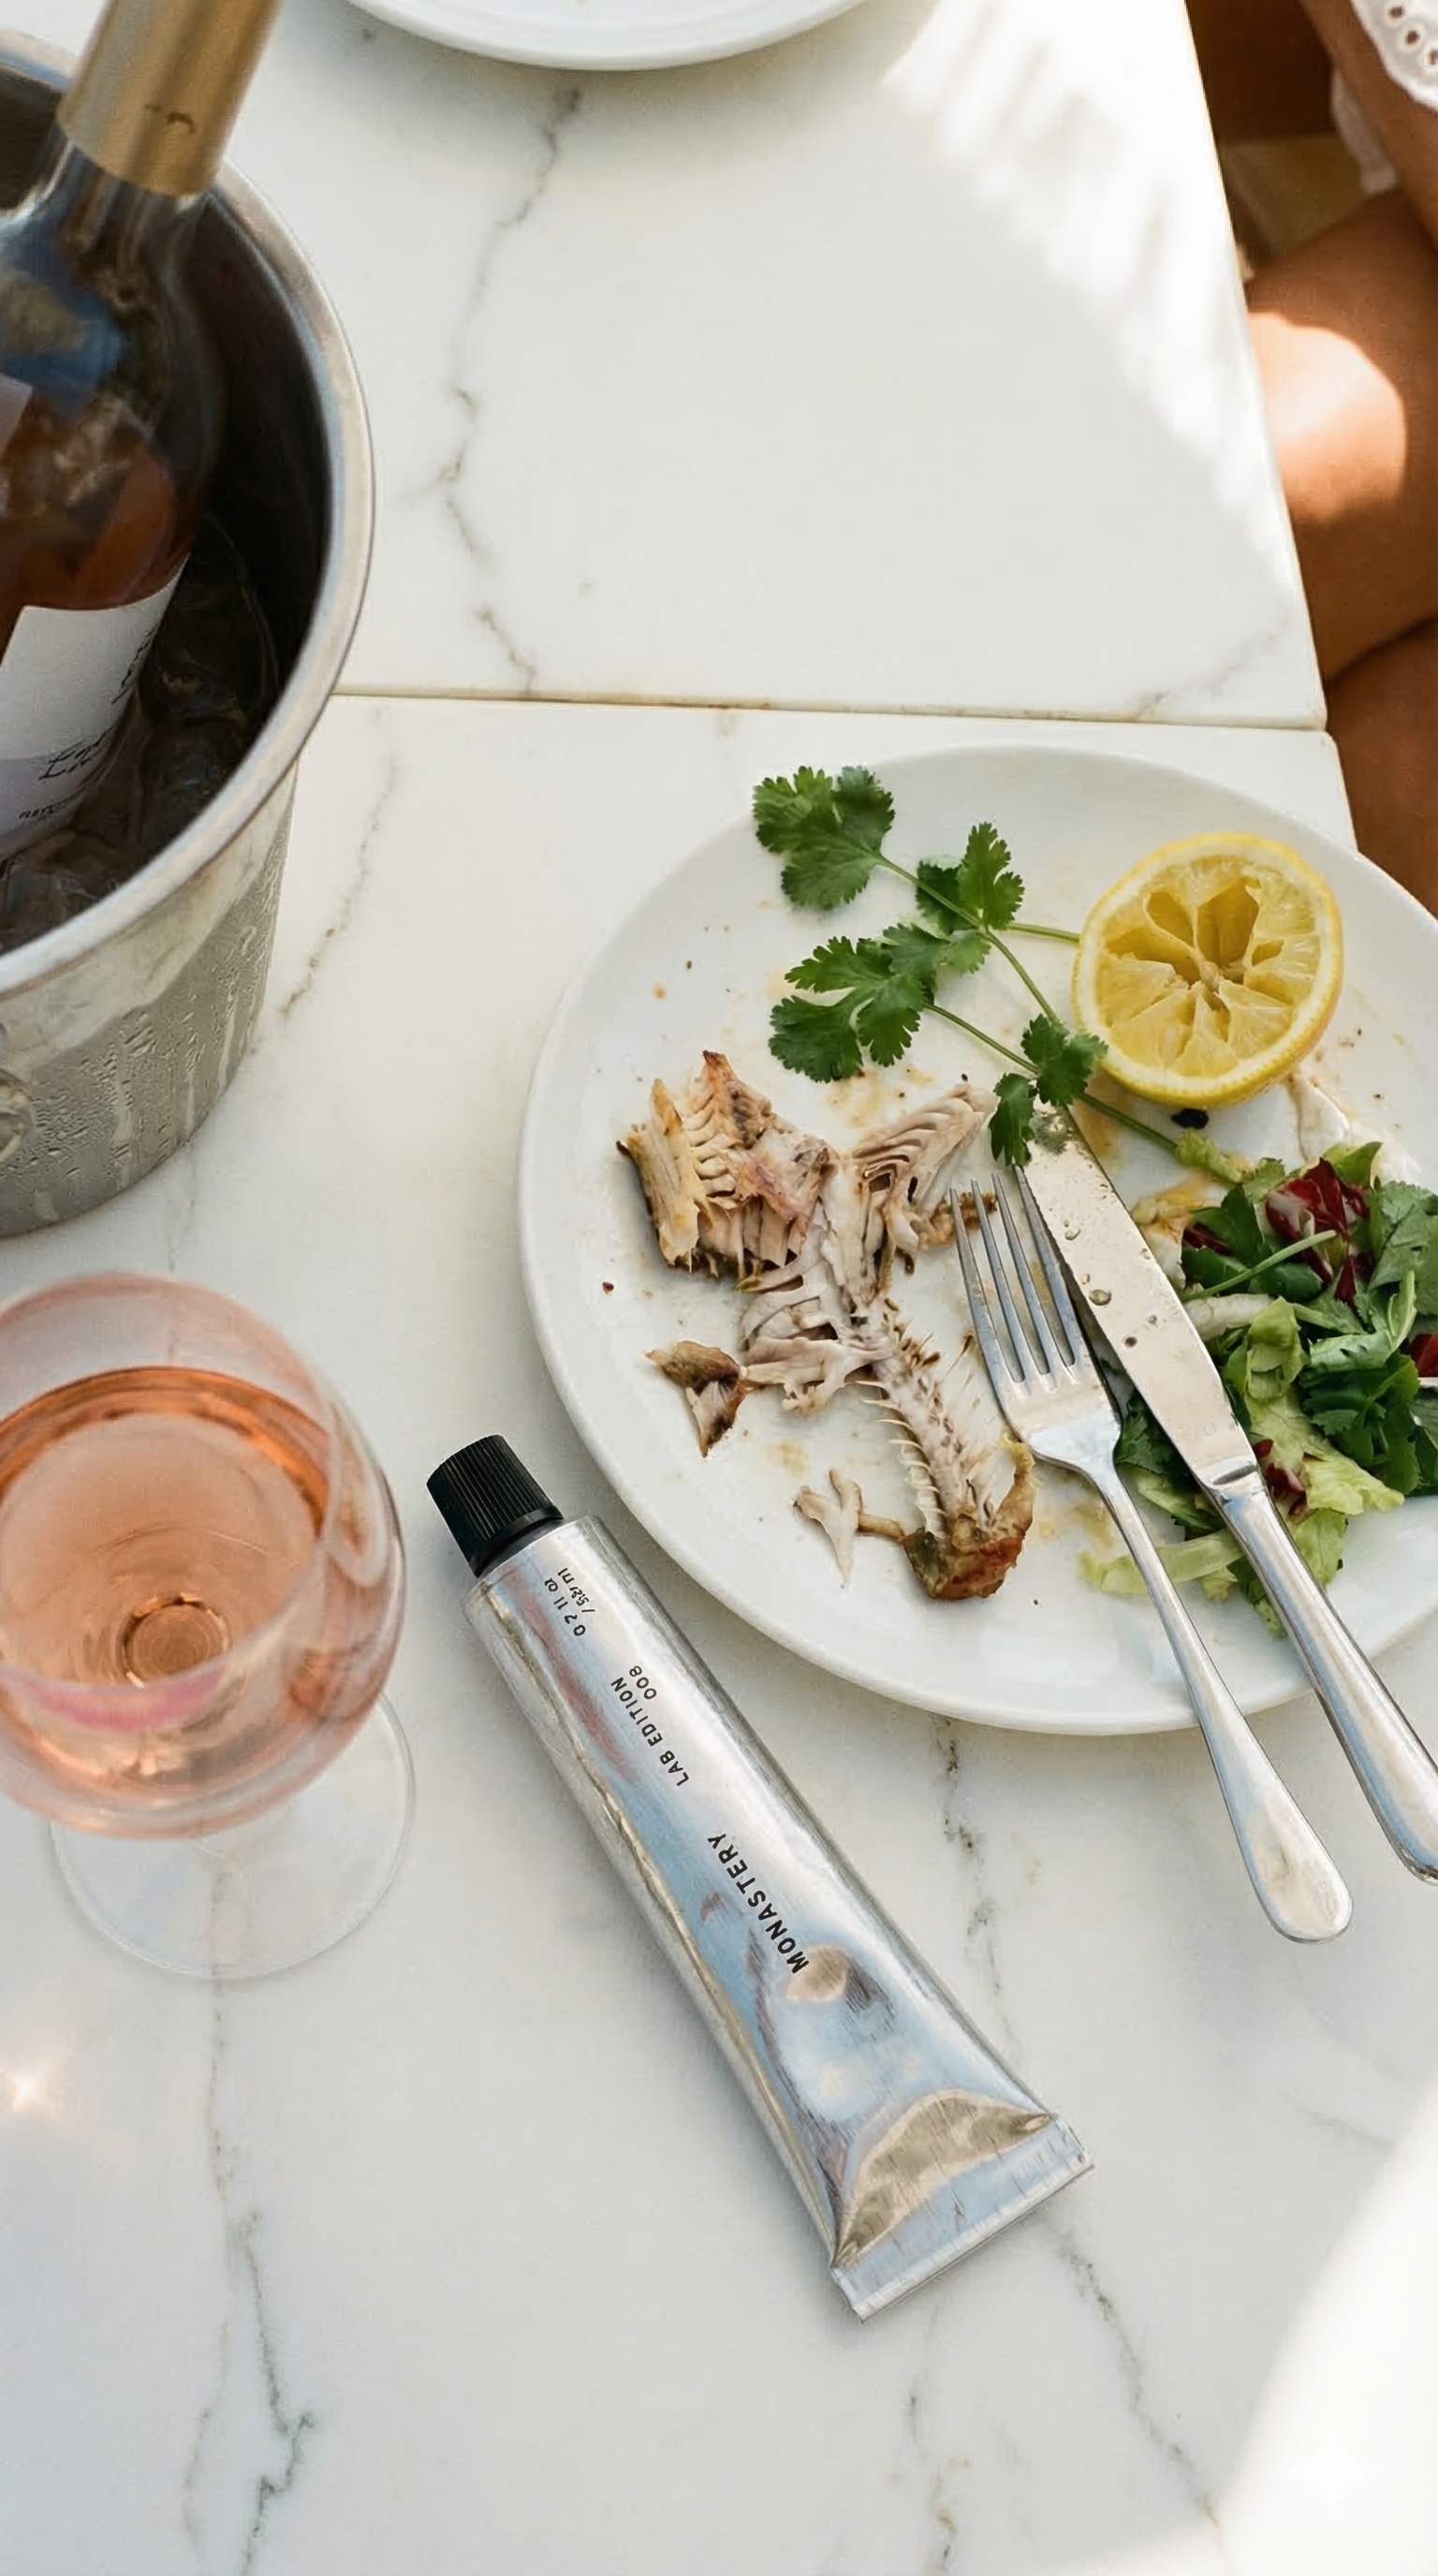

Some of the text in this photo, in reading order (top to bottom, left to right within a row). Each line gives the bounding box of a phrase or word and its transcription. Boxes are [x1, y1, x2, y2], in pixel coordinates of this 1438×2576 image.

[610, 1676, 690, 1787] LAB EDITION
[629, 1665, 657, 1700] 008
[707, 1833, 810, 1974] MONASTERY
